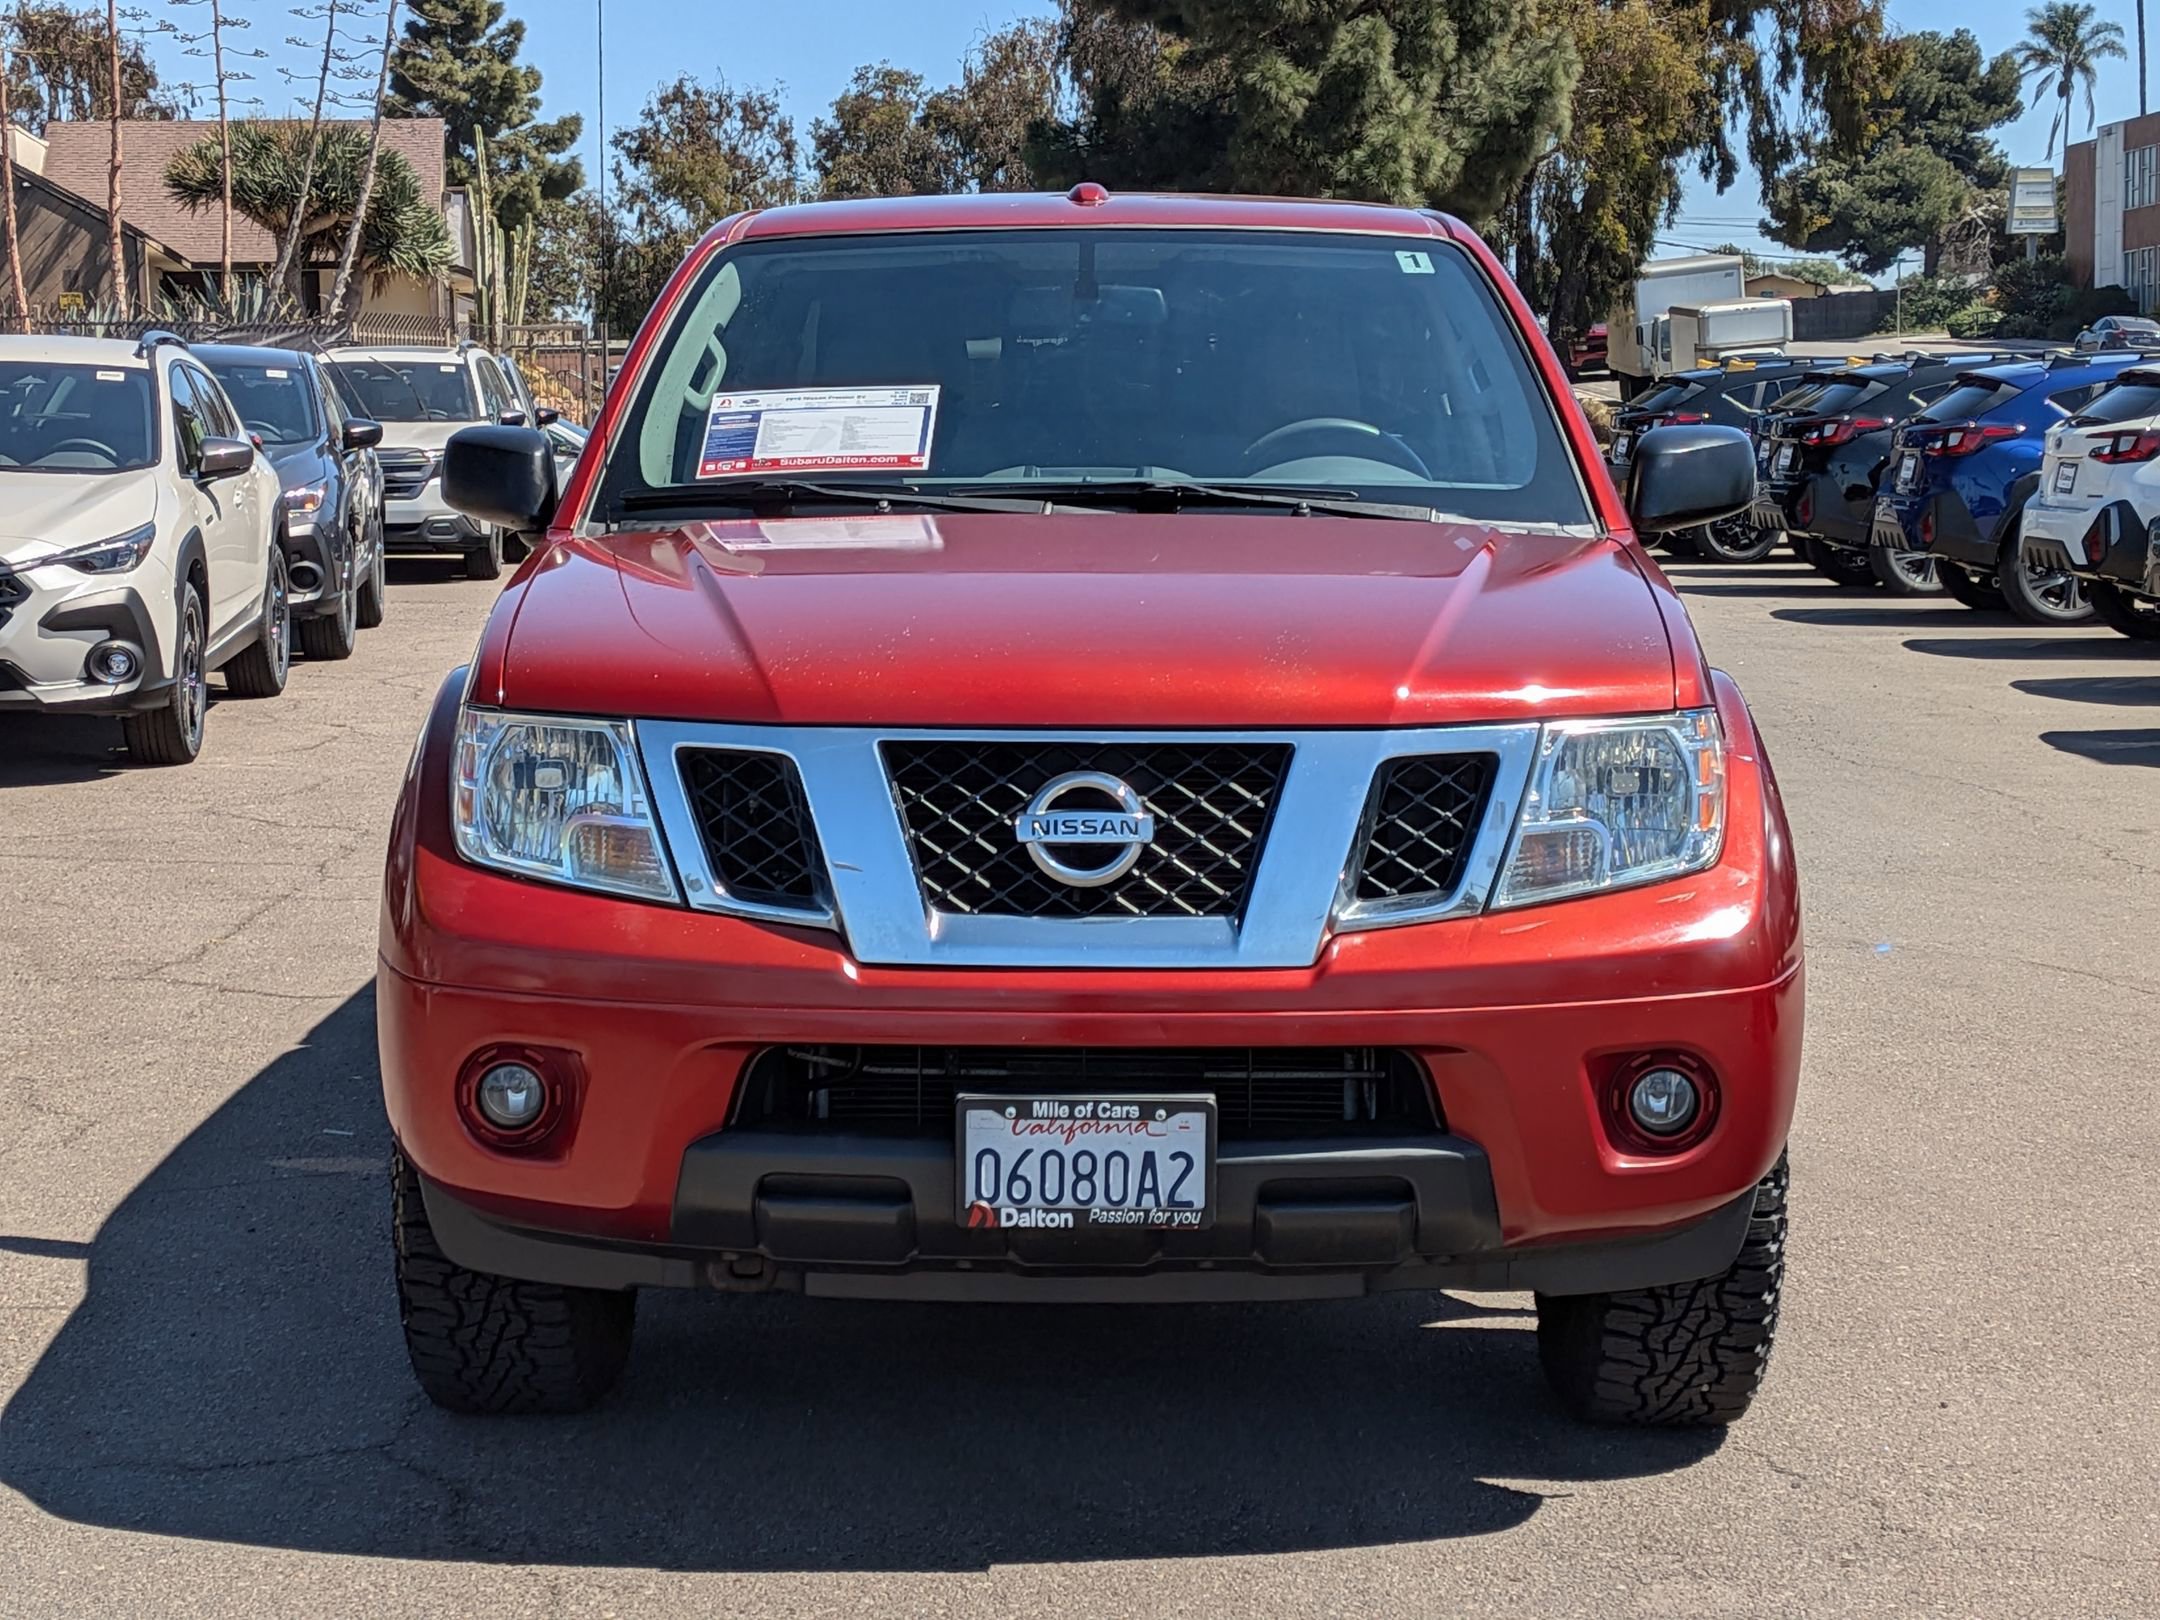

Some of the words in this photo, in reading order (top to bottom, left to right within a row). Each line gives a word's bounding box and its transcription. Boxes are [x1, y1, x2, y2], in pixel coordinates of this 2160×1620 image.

[1404, 254, 1421, 268] 1
[780, 455, 898, 466] SubaruDalton.com
[1031, 819, 1139, 836] NISSAN
[1032, 1101, 1069, 1118] Mile
[1074, 1101, 1094, 1118] of
[1097, 1102, 1140, 1119] Cars
[1012, 1118, 1167, 1146] California
[975, 1147, 1195, 1208] 06080A2
[1000, 1207, 1074, 1229] Dalton
[1089, 1208, 1145, 1225] Passion
[1147, 1207, 1171, 1225] for
[1172, 1210, 1202, 1227] you
